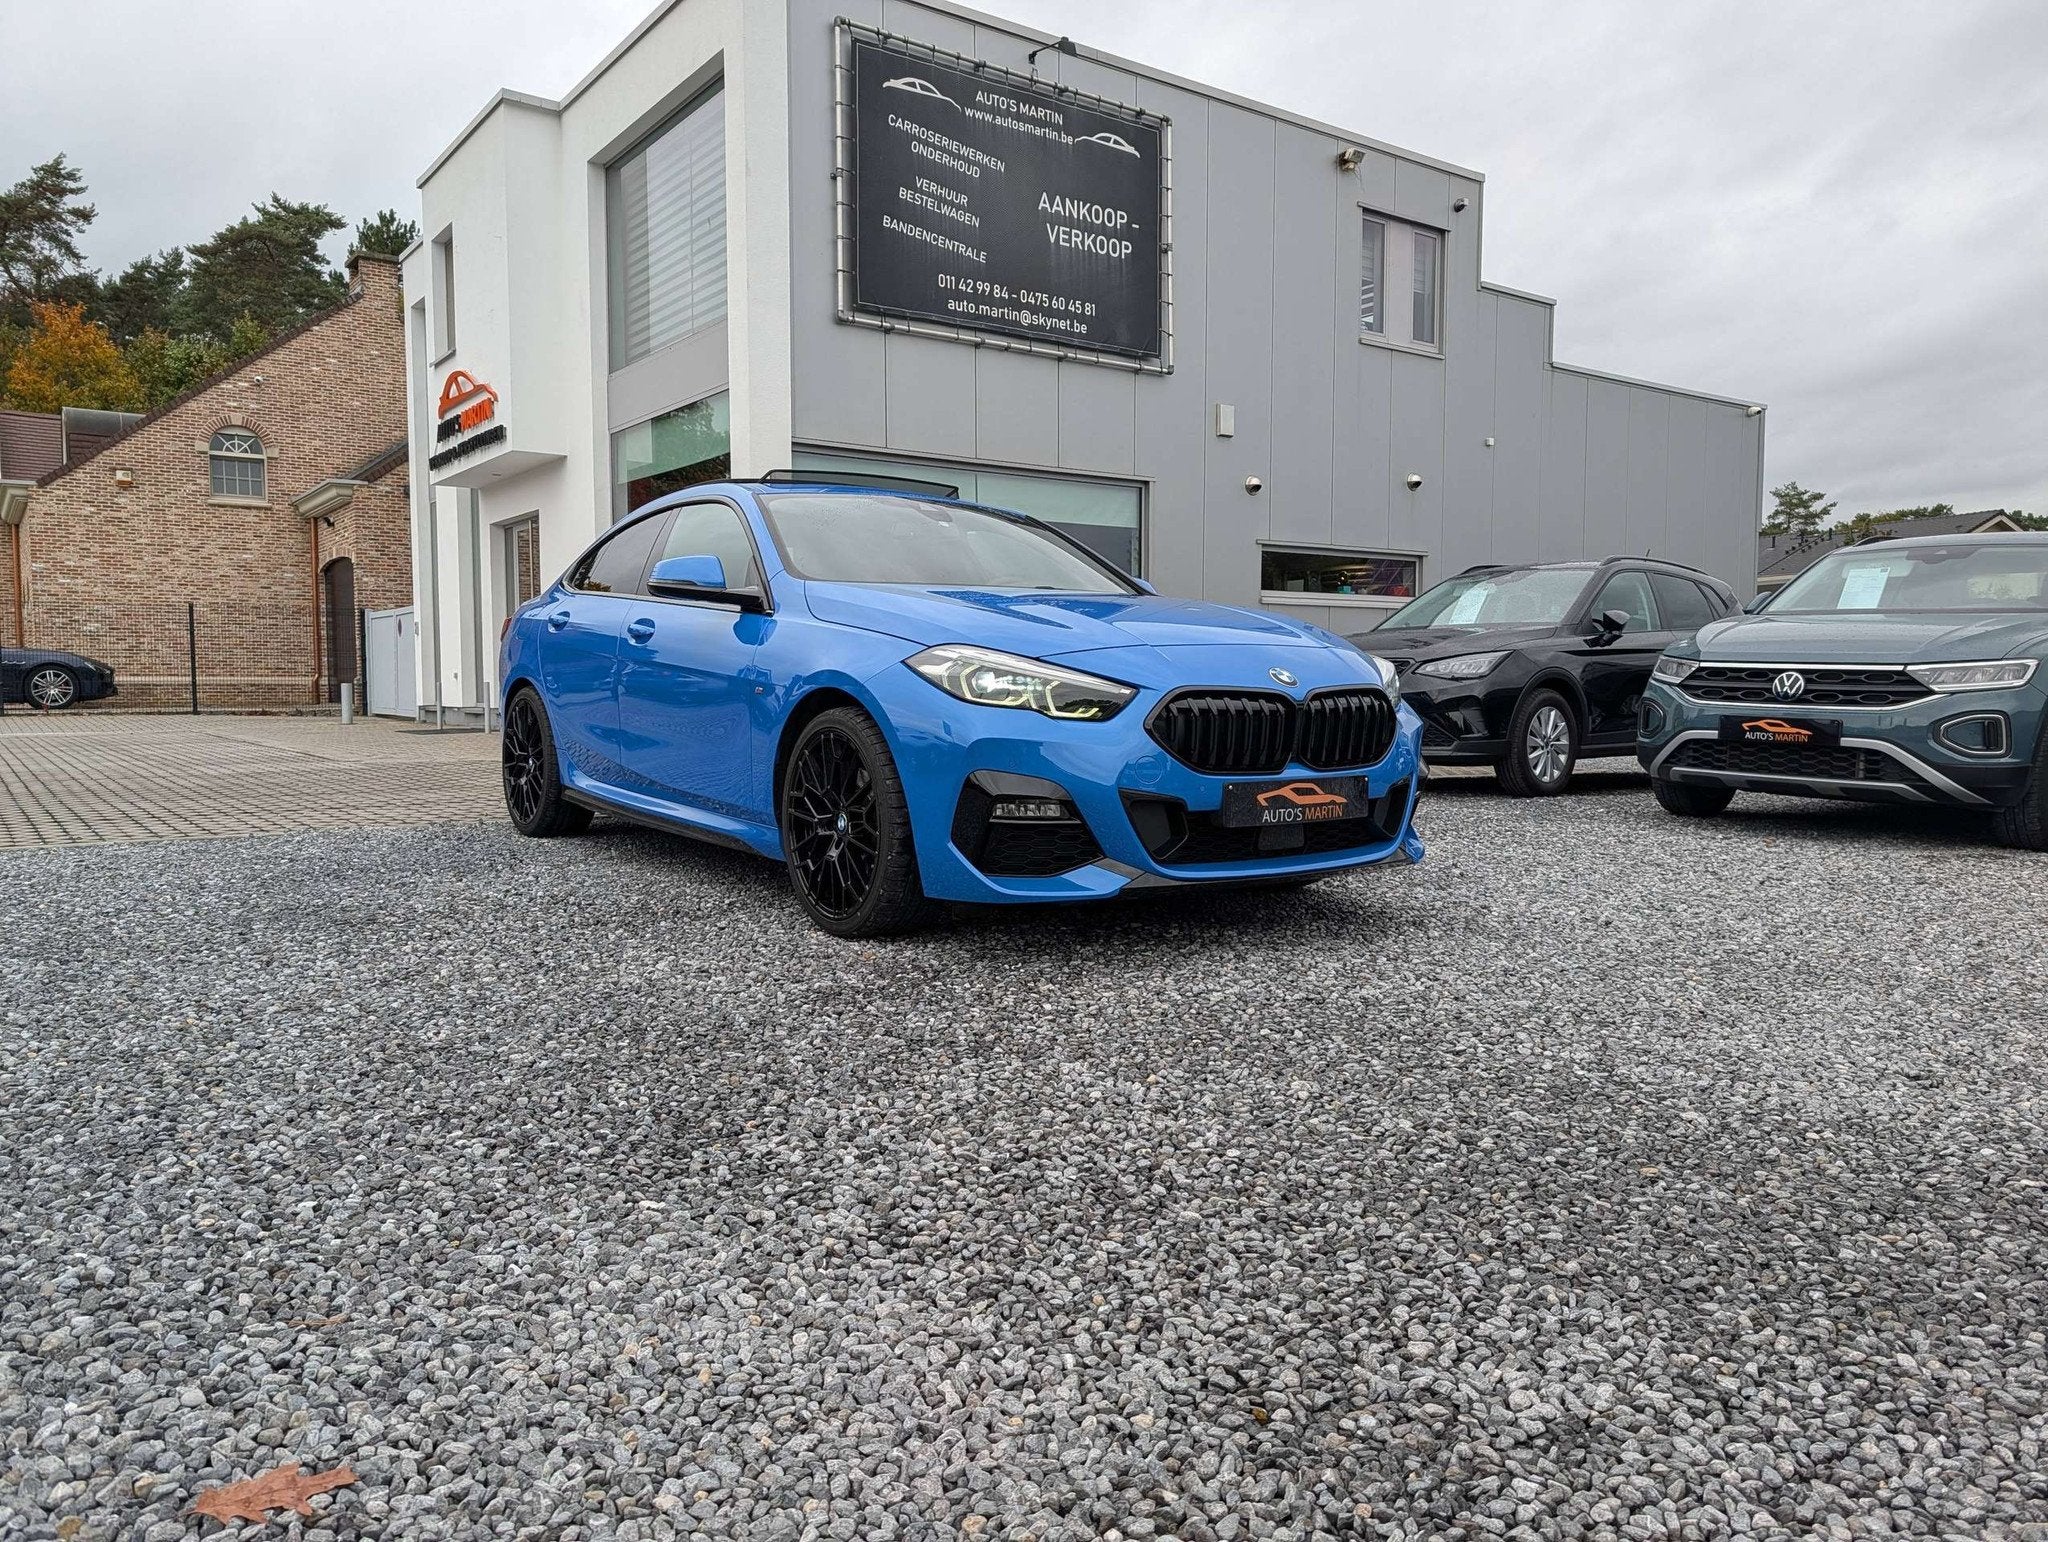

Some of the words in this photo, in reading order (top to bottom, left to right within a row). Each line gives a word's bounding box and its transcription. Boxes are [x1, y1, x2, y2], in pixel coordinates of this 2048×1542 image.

[964, 106, 1074, 145] www.autosmartin.be
[975, 90, 1018, 113] AUTO'S
[1019, 103, 1063, 126] MARTIN
[888, 114, 1005, 173] CARROSERIEWERKEN
[911, 141, 980, 178] ONDERHOUD
[899, 186, 980, 228] BESTELWAGEN
[915, 175, 968, 207] VERHUUR
[1038, 191, 1128, 229] AANKOOP
[882, 214, 988, 264] BANDENCENTRALE
[1046, 222, 1133, 259] VERKOOP
[938, 273, 956, 290] 011
[958, 277, 974, 293] 42
[976, 281, 991, 296] 99
[993, 284, 1009, 300] 84
[1020, 289, 1049, 308] 0475
[1051, 295, 1066, 311] 60
[1068, 299, 1082, 314] 45
[1084, 302, 1096, 317] 81
[947, 299, 1088, 334] auto.martin@skynet.be
[1745, 731, 1774, 741] AUTO'S
[1775, 732, 1809, 742] MARTIN
[1262, 807, 1303, 823] AUTO'S
[1304, 804, 1343, 820] MARTIN
